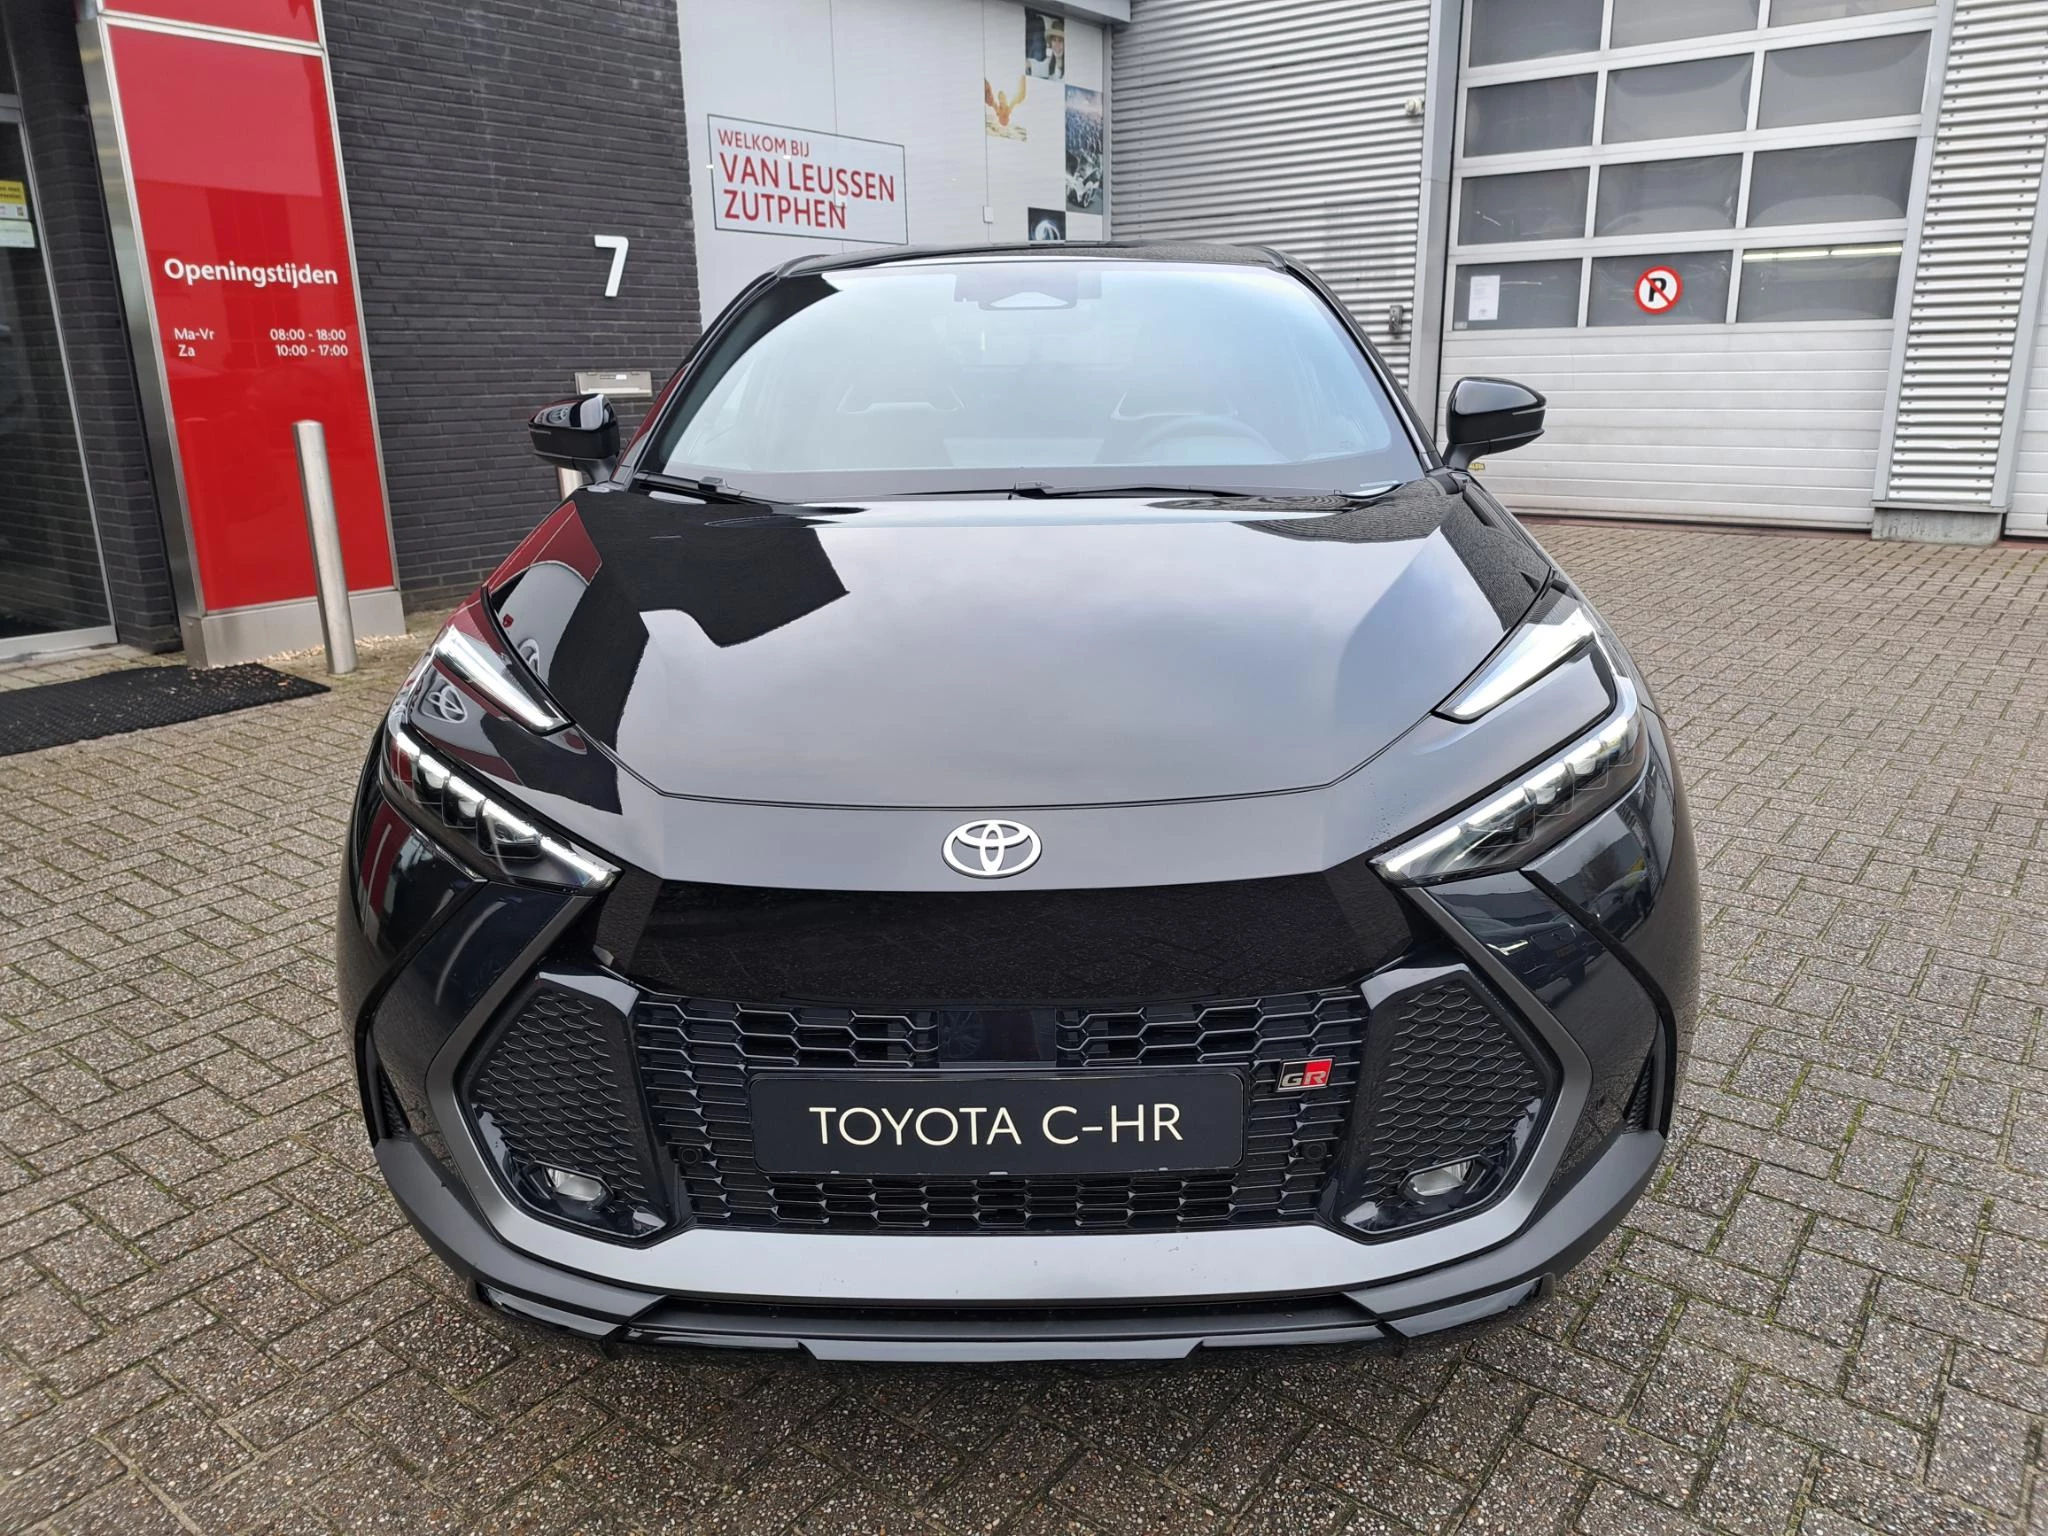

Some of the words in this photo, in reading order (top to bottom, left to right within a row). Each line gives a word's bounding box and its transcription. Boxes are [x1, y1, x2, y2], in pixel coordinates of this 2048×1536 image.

[717, 128, 787, 155] WELKOM
[791, 140, 810, 158] BIJ
[719, 152, 780, 189] VAN
[788, 161, 896, 203] LEUSSEN
[723, 189, 847, 230] ZUTPHEN
[164, 258, 338, 289] Openingstijden
[594, 234, 629, 297] 7
[174, 327, 216, 341] Ma-Vr
[269, 328, 306, 342] 08:00
[315, 328, 347, 342] 18:00
[178, 344, 196, 357] Za
[275, 343, 308, 357] 10:00
[318, 344, 349, 357] 17:00
[1281, 1070, 1327, 1087] GR
[808, 1106, 1022, 1147] TOYOTA
[1041, 1102, 1184, 1146] C-HR
